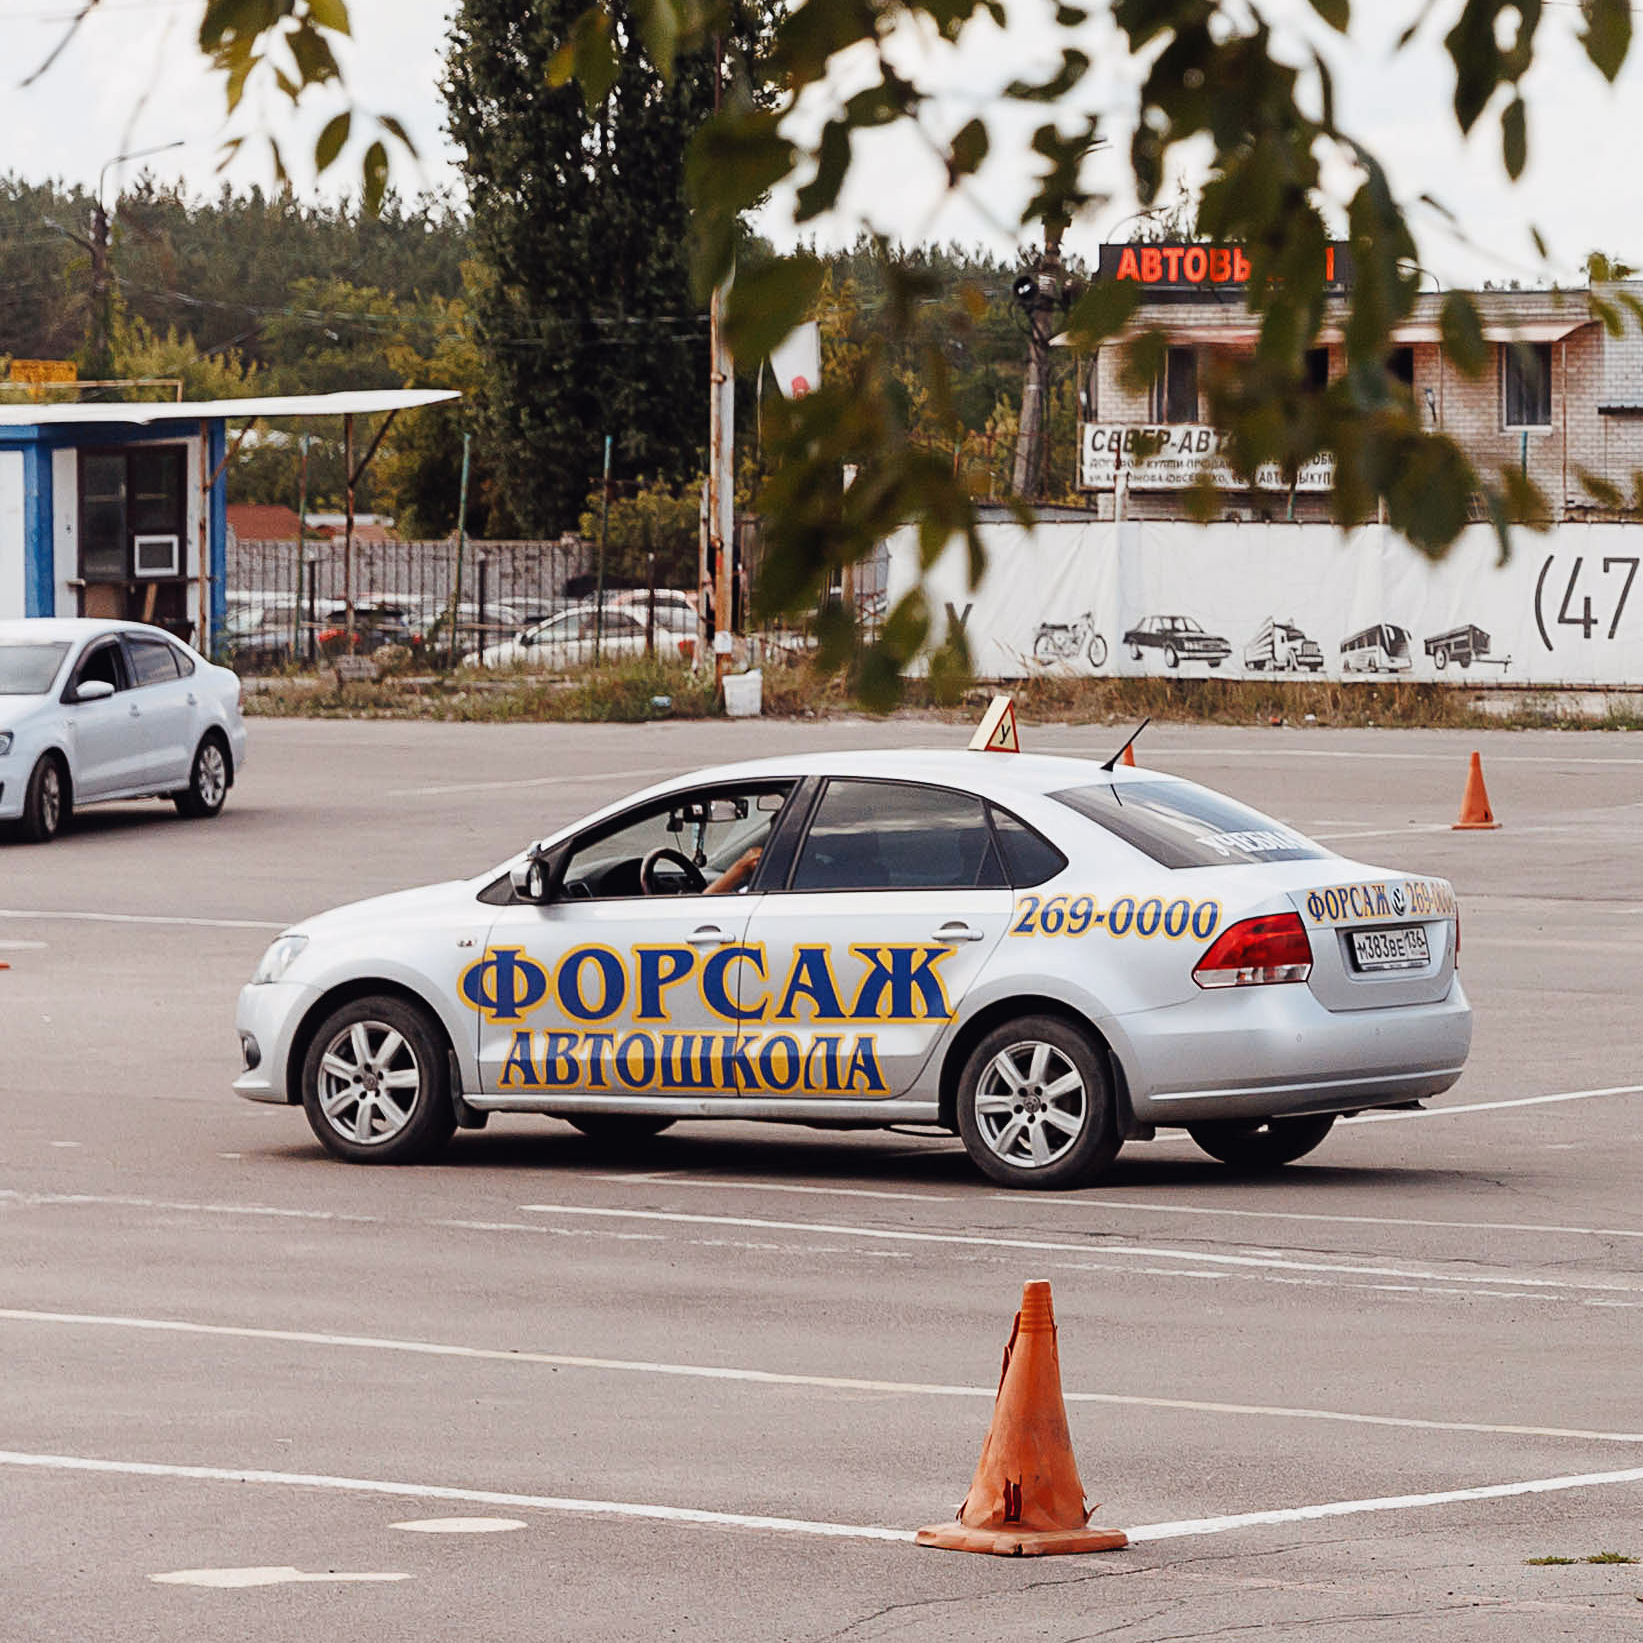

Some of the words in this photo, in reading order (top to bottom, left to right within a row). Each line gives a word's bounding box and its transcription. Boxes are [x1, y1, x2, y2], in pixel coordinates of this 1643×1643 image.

[1116, 247, 1335, 282] АВТОВЫ
[999, 723, 1011, 745] У
[1010, 893, 1221, 941] 269-0000
[1306, 883, 1393, 923] ФОРСАЖ
[1356, 931, 1406, 960] М383ВЕ
[1404, 929, 1425, 949] 136
[457, 943, 957, 1025] ФОРСАЖ
[498, 1028, 890, 1095] АВТОШКОЛА
